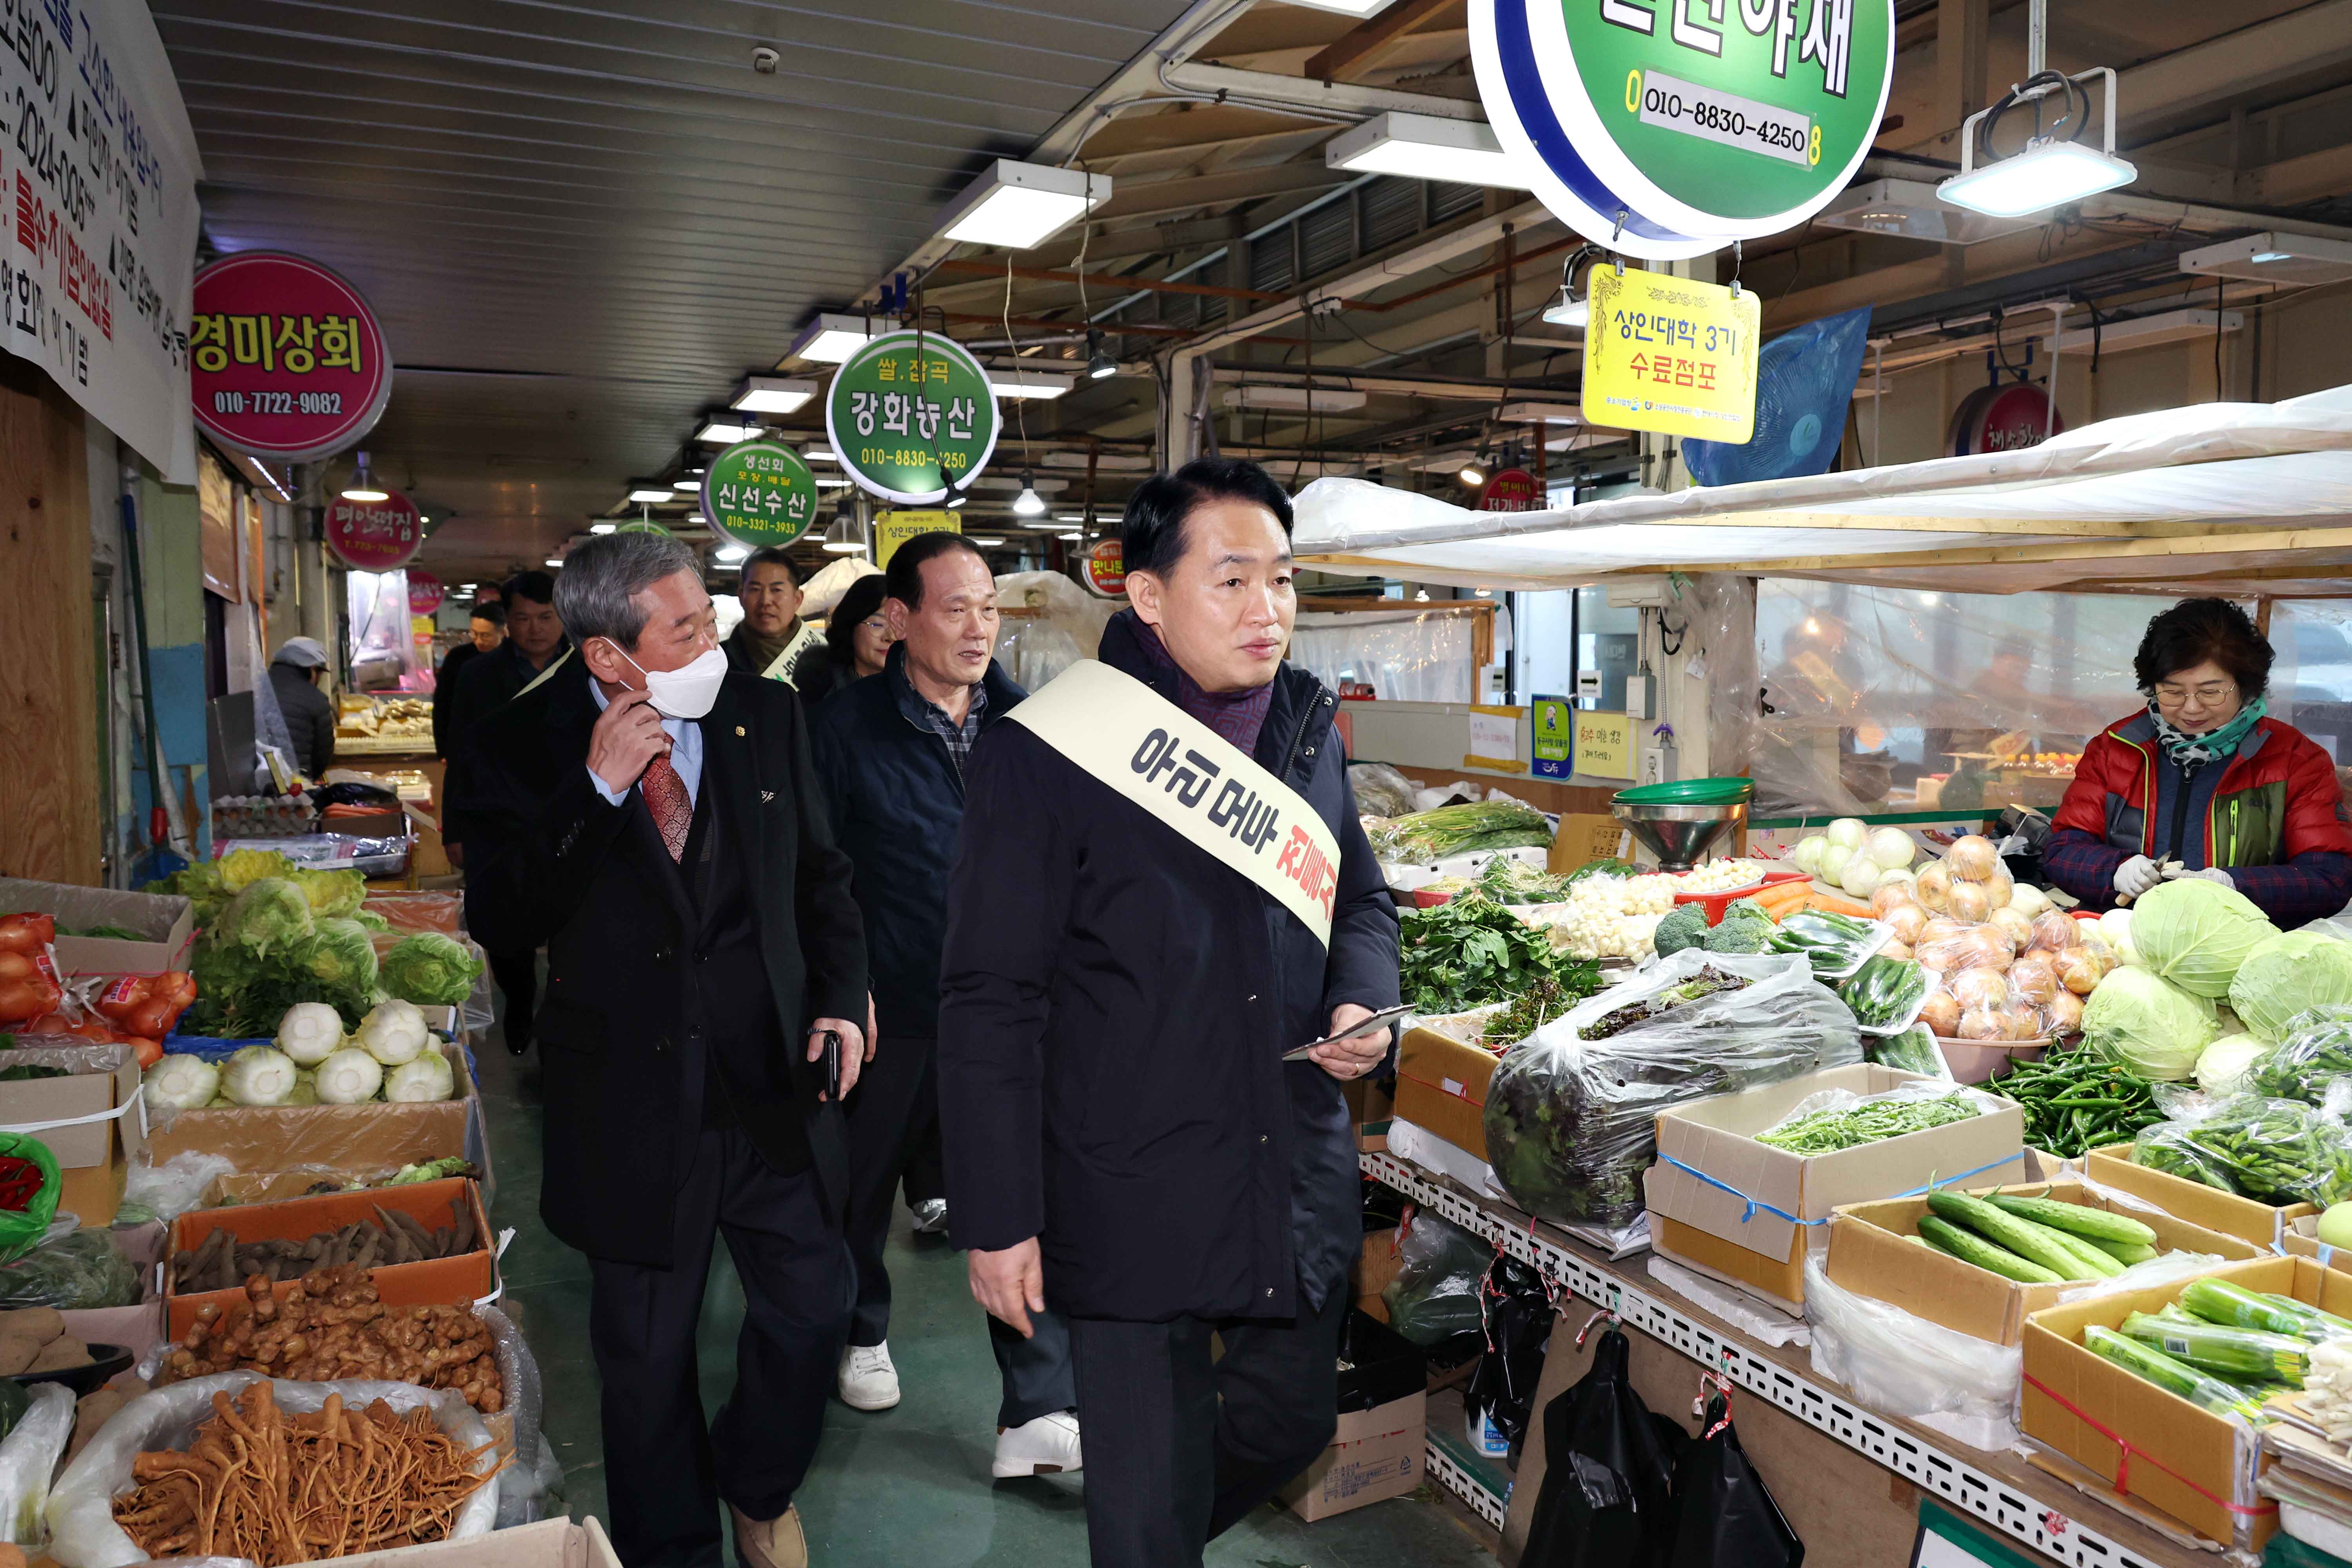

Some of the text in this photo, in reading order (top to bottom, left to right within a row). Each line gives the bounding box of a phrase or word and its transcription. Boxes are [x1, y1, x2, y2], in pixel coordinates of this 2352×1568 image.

[1600, 0, 1851, 99] 야채
[1644, 88, 1805, 152] 010-8830-4250
[191, 314, 363, 374] 경미상회
[1614, 309, 1736, 356] 상인대학 3기
[1630, 352, 1716, 390] 수료점포
[214, 392, 341, 415] 010-7722-9082
[851, 392, 976, 440] 강화농산
[744, 454, 784, 473] 생선회
[719, 483, 806, 519] 신선수산
[726, 515, 796, 534] 010-3321-3933
